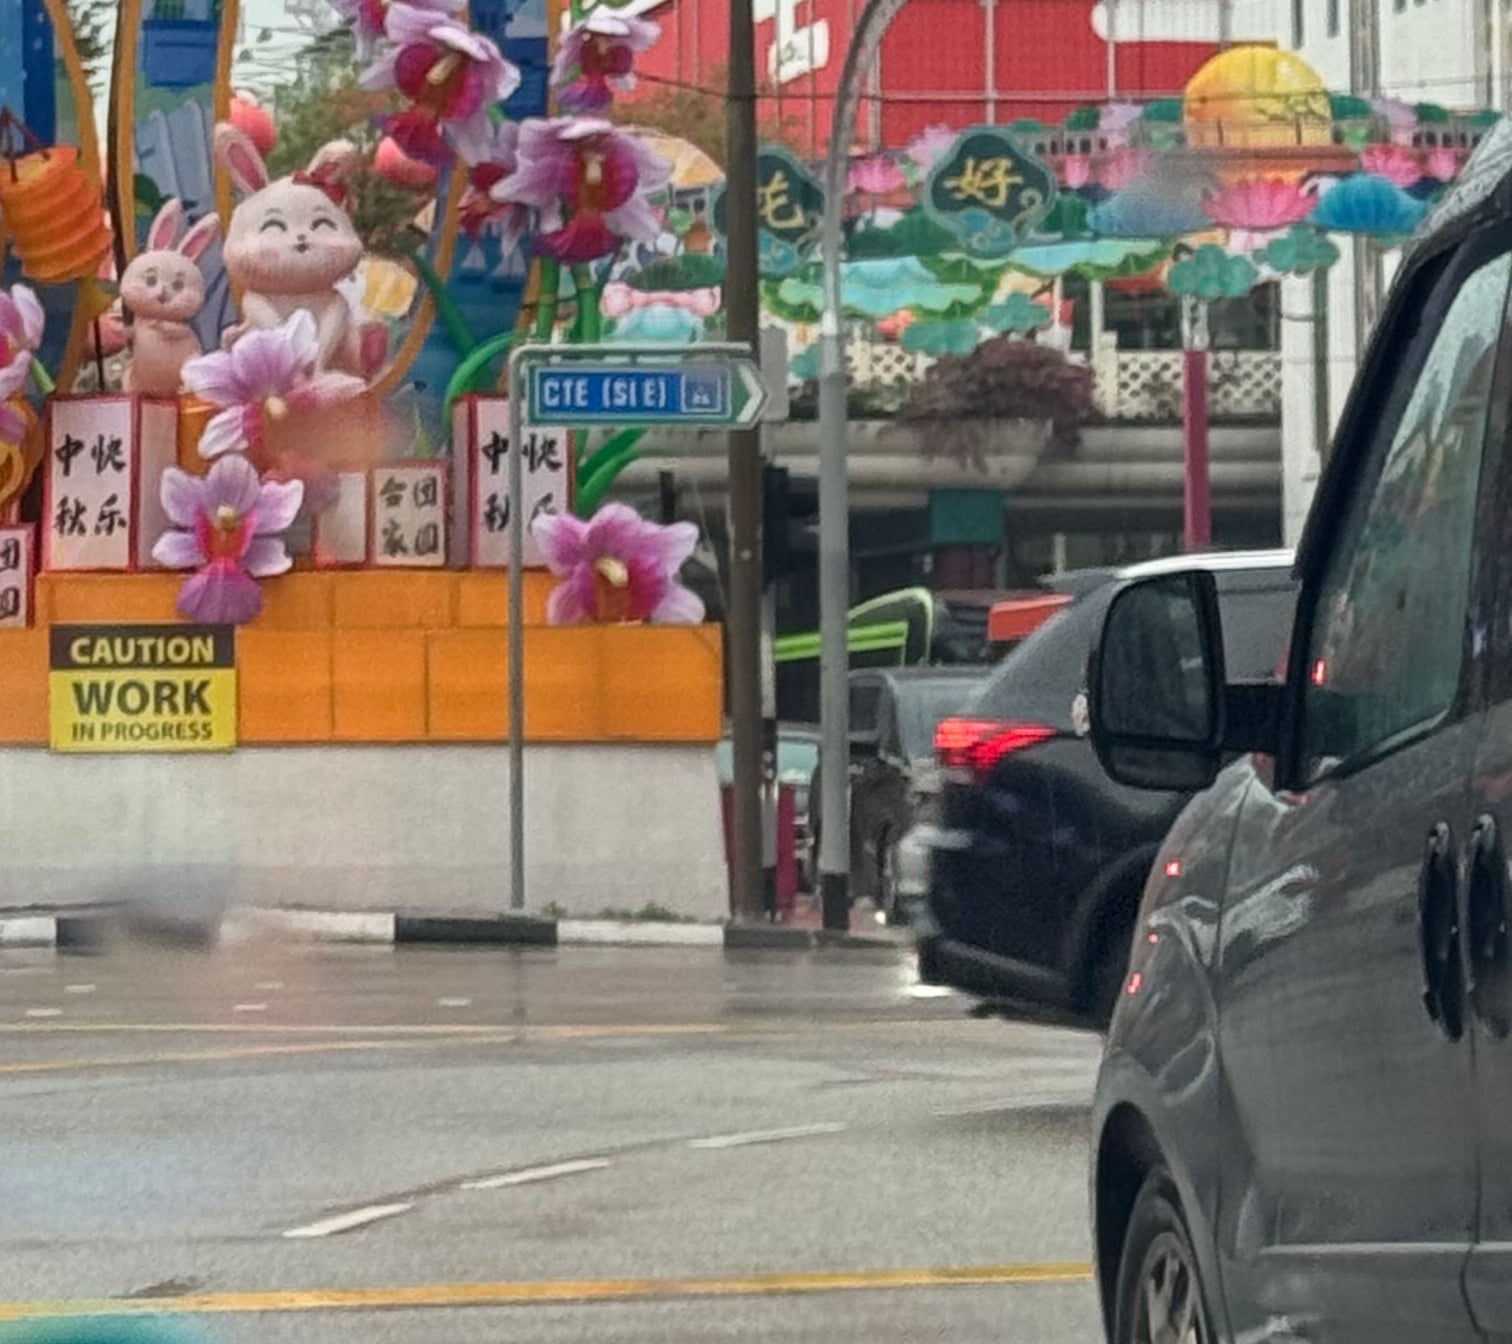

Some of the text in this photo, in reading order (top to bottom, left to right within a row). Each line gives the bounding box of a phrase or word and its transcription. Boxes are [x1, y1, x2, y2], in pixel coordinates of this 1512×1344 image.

[944, 156, 1024, 207] 好
[544, 380, 588, 407] CTE
[70, 636, 215, 665] CAUTION
[72, 679, 212, 716] WORK
[72, 721, 213, 741] IN PROGRESS
